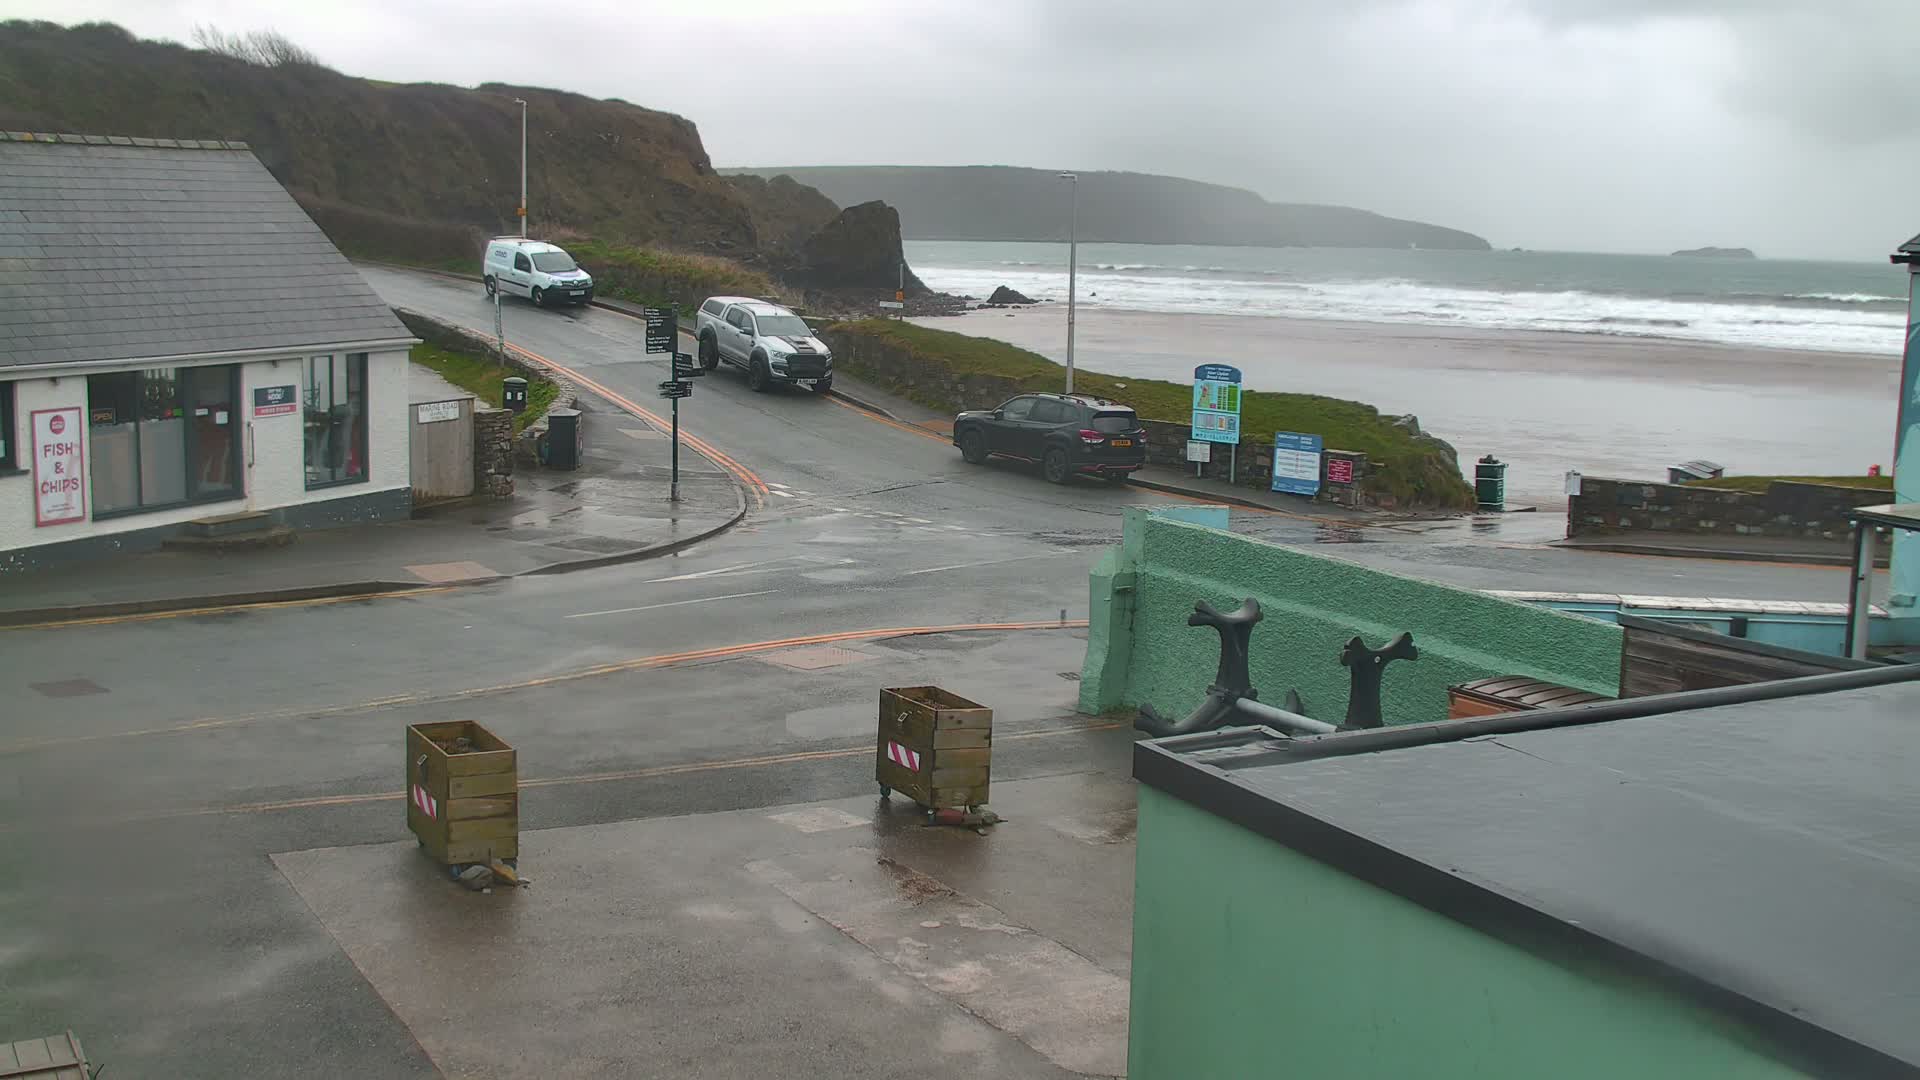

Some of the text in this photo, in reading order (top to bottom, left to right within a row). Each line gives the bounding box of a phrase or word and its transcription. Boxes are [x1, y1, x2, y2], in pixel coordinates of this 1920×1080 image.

[420, 402, 457, 411] MARINE ROAD
[43, 442, 73, 458] FISH
[54, 461, 65, 475] &
[41, 478, 80, 494] CHIPS
